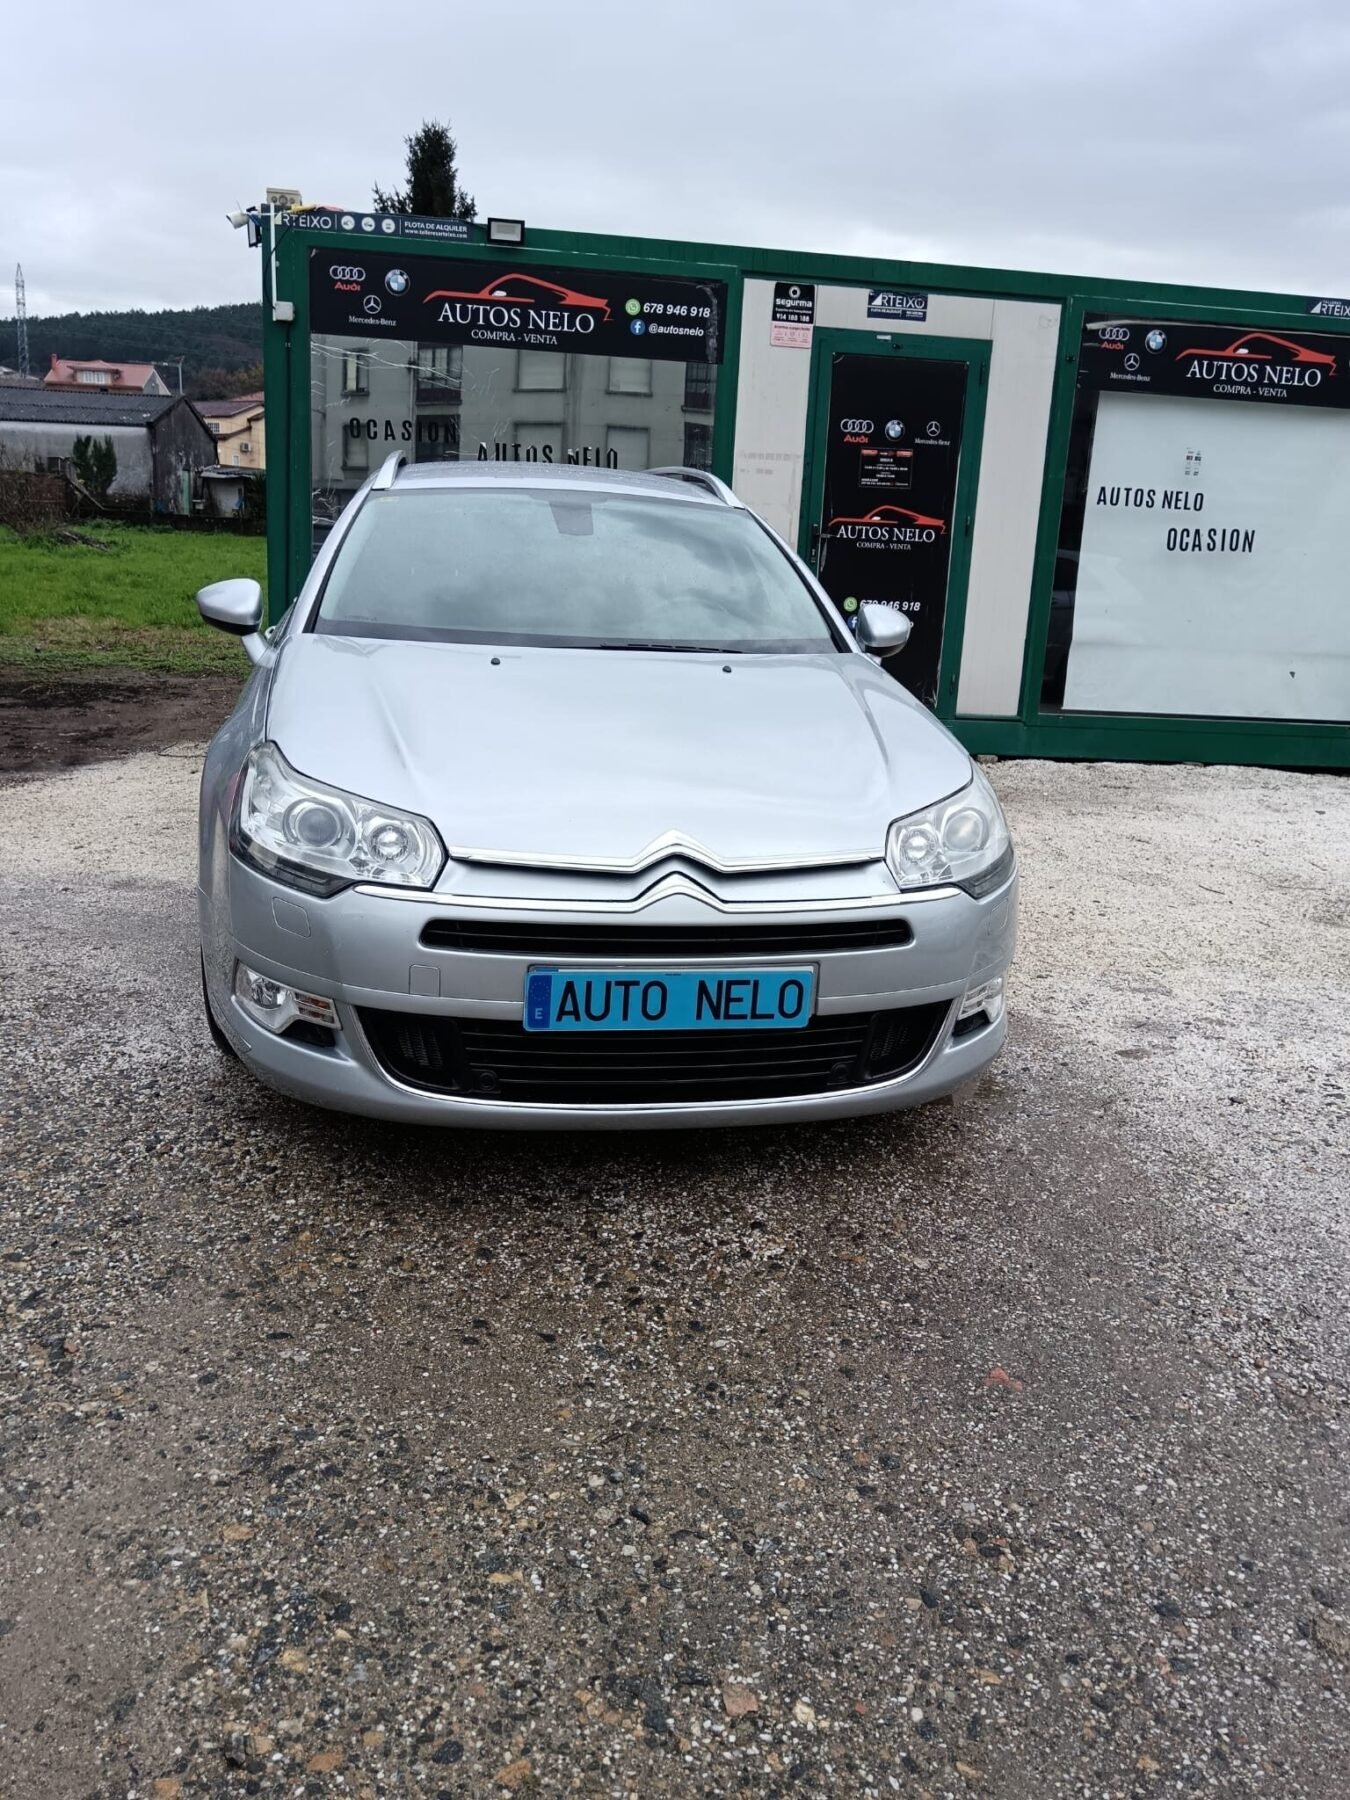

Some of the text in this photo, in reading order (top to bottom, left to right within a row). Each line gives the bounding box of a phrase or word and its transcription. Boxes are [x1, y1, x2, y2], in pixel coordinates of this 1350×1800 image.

[404, 221, 425, 229] FLOTA
[436, 224, 468, 232] ALQUILER
[334, 281, 361, 291] Audi
[643, 302, 710, 318] 678 946 918
[776, 298, 812, 308] segurma
[348, 315, 397, 326] Mercedes-Benz
[437, 302, 594, 334] AUTOS NELO
[648, 323, 704, 337] @autosnelo
[471, 330, 516, 341] COMPRA
[523, 333, 558, 345] VENTA
[1101, 341, 1124, 350] Audi
[1109, 372, 1151, 382] Mercedes-Benz
[1185, 359, 1321, 387] AUTOS NELO
[1213, 384, 1251, 395] COMPRA
[1258, 387, 1287, 398] VENTA
[350, 417, 457, 442] OCASION
[843, 434, 869, 443] Audi
[477, 441, 554, 464] AUTOS
[1096, 486, 1204, 511] AUTOS NELO
[836, 525, 935, 543] AUTOS NELO
[1166, 528, 1255, 552] OCASION
[856, 541, 885, 550] COMPRA
[890, 543, 912, 551] VENTA
[902, 601, 921, 611] 918
[555, 979, 804, 1022] AUTO NELO
[535, 1008, 543, 1019] E
